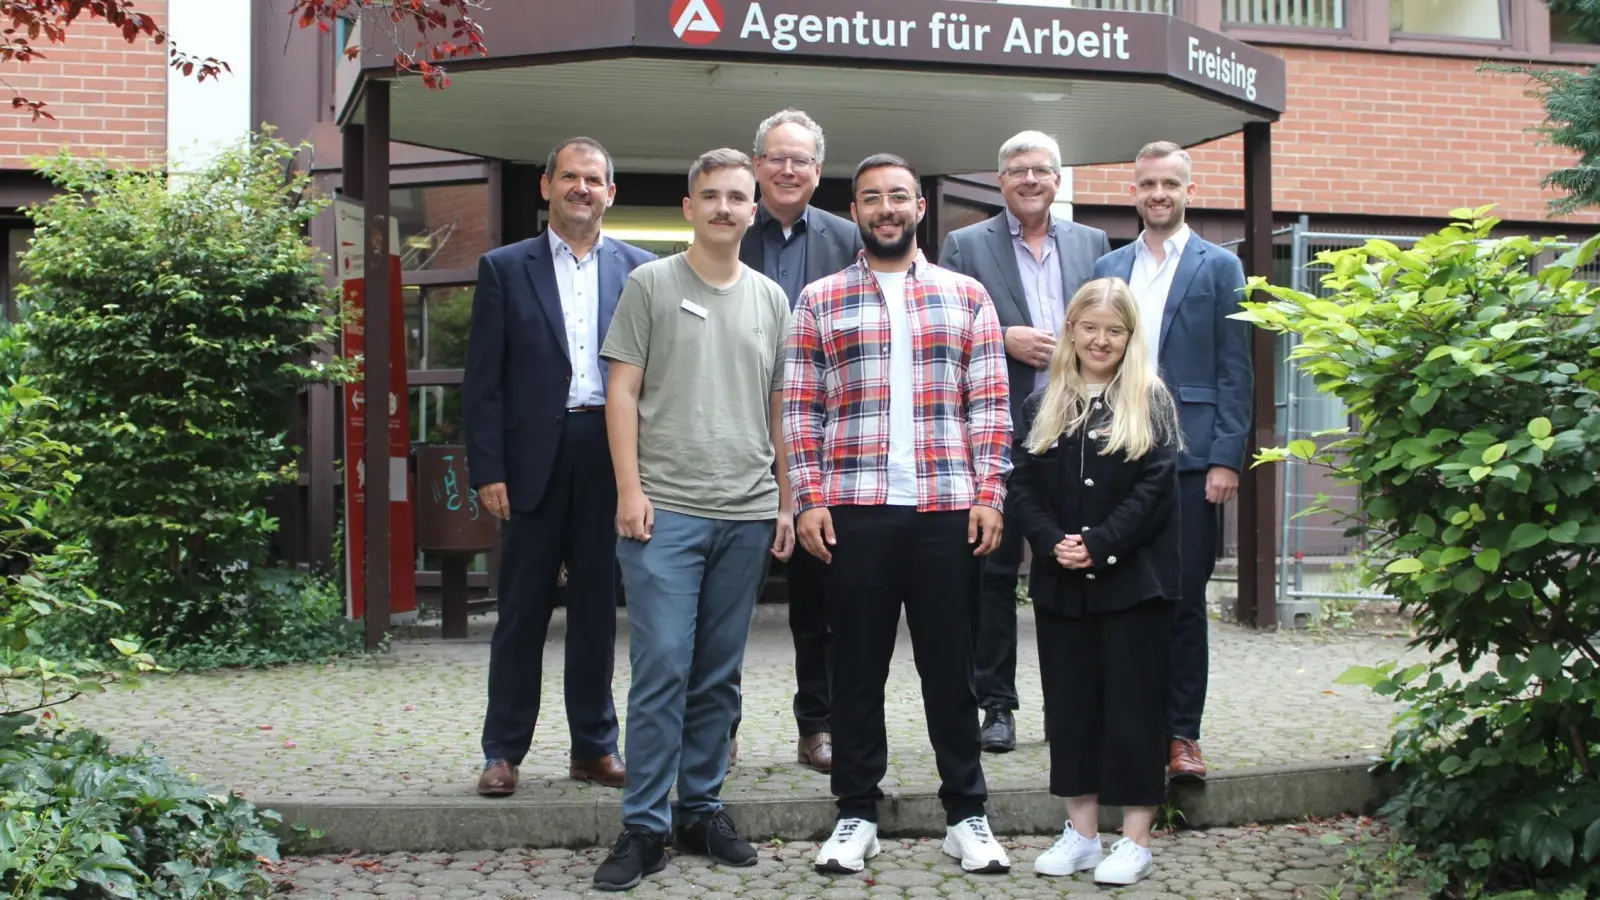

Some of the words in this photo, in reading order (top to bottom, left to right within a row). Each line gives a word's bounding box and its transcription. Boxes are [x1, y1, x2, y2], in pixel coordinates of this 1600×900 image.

[739, 2, 917, 51] Agentur
[928, 12, 991, 51] für
[1003, 17, 1130, 60] Arbeit
[1188, 36, 1257, 101] Freising
